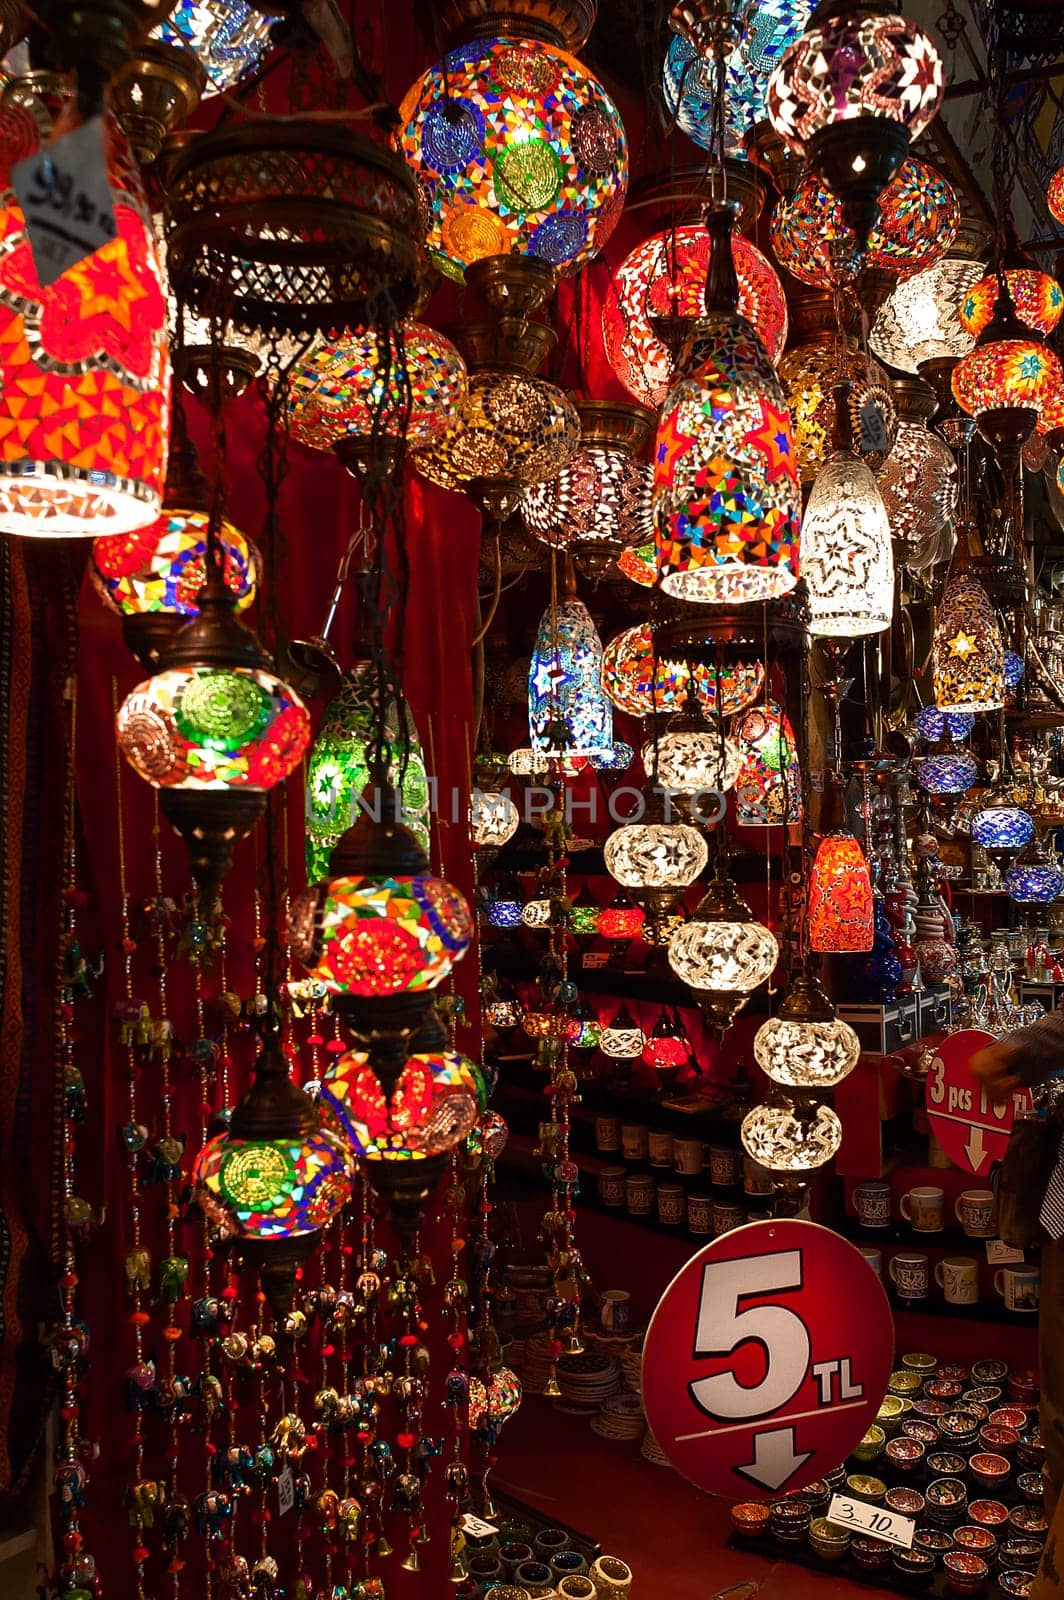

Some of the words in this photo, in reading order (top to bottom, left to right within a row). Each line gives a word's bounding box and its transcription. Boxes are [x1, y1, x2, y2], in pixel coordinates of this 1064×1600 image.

[930, 1056, 945, 1104] 3
[948, 1086, 972, 1113] pcs
[688, 1249, 811, 1421] 5
[812, 1358, 864, 1404] TL
[834, 1502, 855, 1519] 3
[868, 1512, 893, 1532] 10
